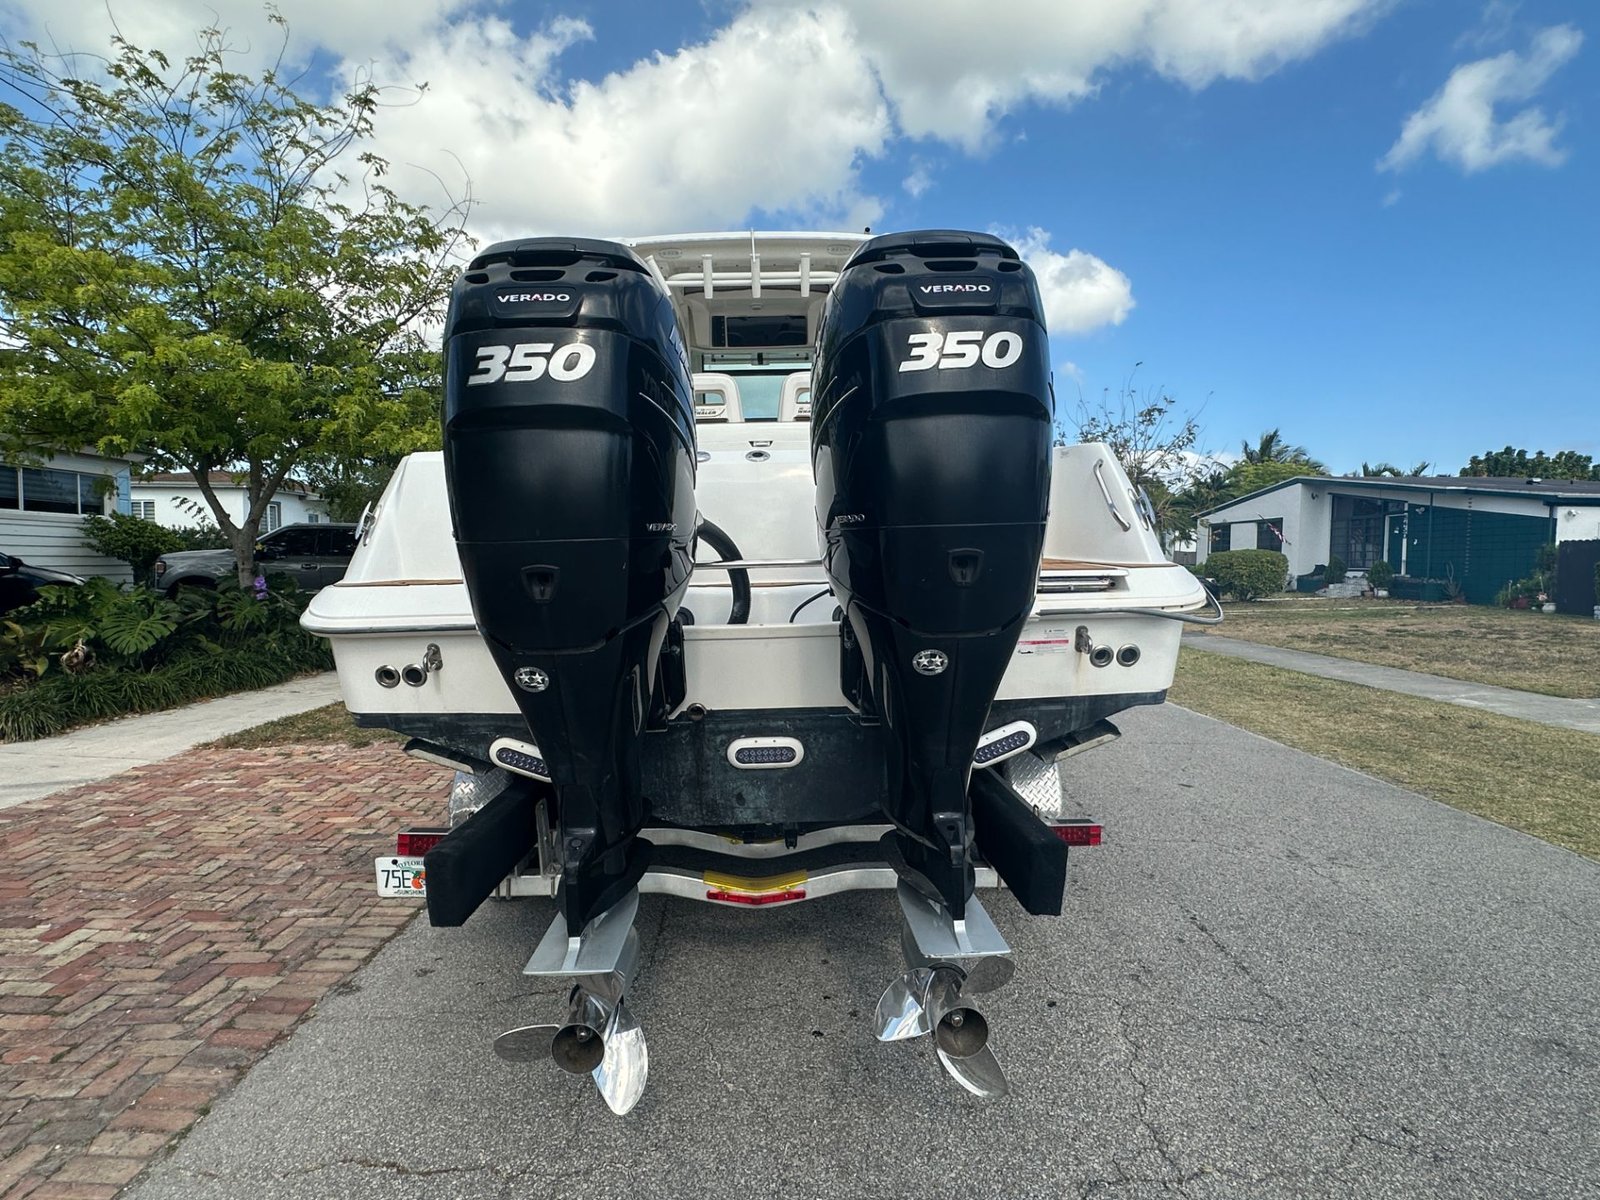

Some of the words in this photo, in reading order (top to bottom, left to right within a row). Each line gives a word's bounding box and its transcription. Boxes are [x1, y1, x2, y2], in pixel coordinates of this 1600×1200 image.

[497, 293, 571, 303] VERADO
[920, 284, 991, 293] VERADO
[899, 331, 1023, 372] 350
[467, 342, 597, 385] 350
[381, 869, 411, 888] 75E
